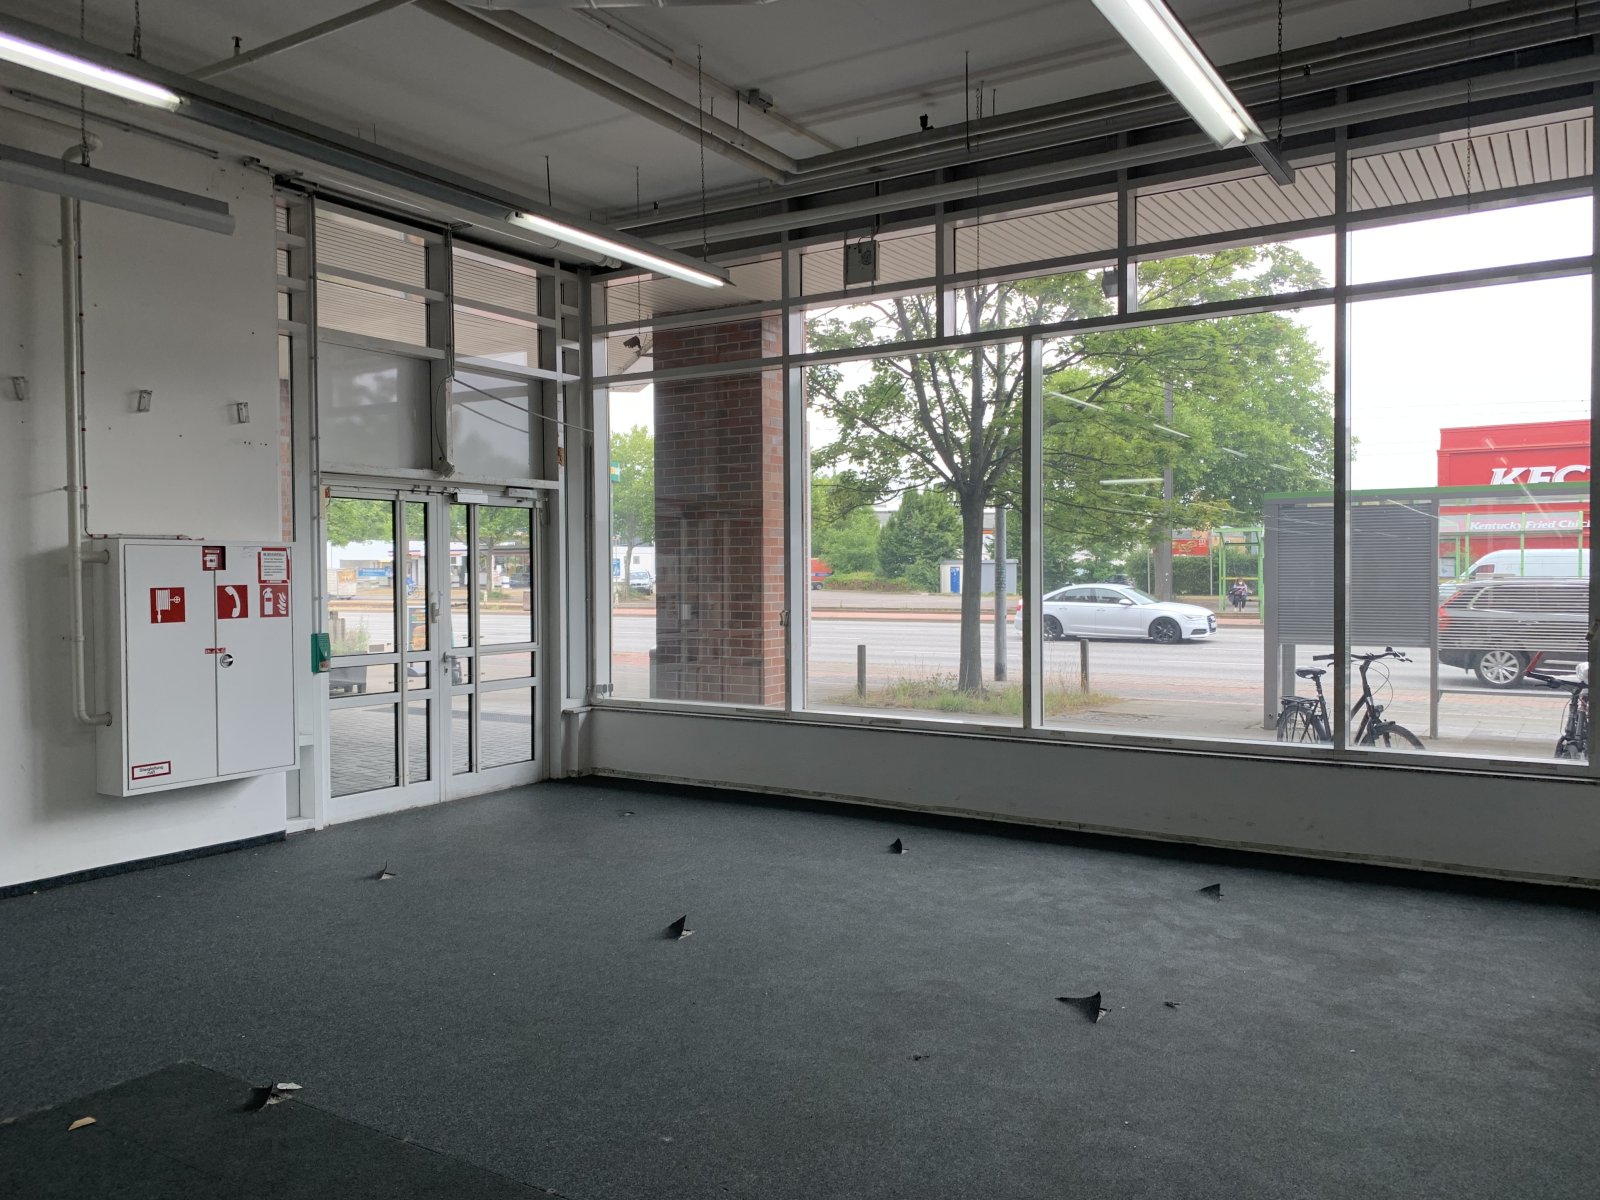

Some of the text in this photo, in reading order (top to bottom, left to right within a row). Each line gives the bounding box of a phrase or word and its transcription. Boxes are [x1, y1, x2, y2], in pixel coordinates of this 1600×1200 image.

[1490, 465, 1590, 485] KFC
[1470, 521, 1521, 531] Kentucky
[1525, 520, 1557, 529] Fried
